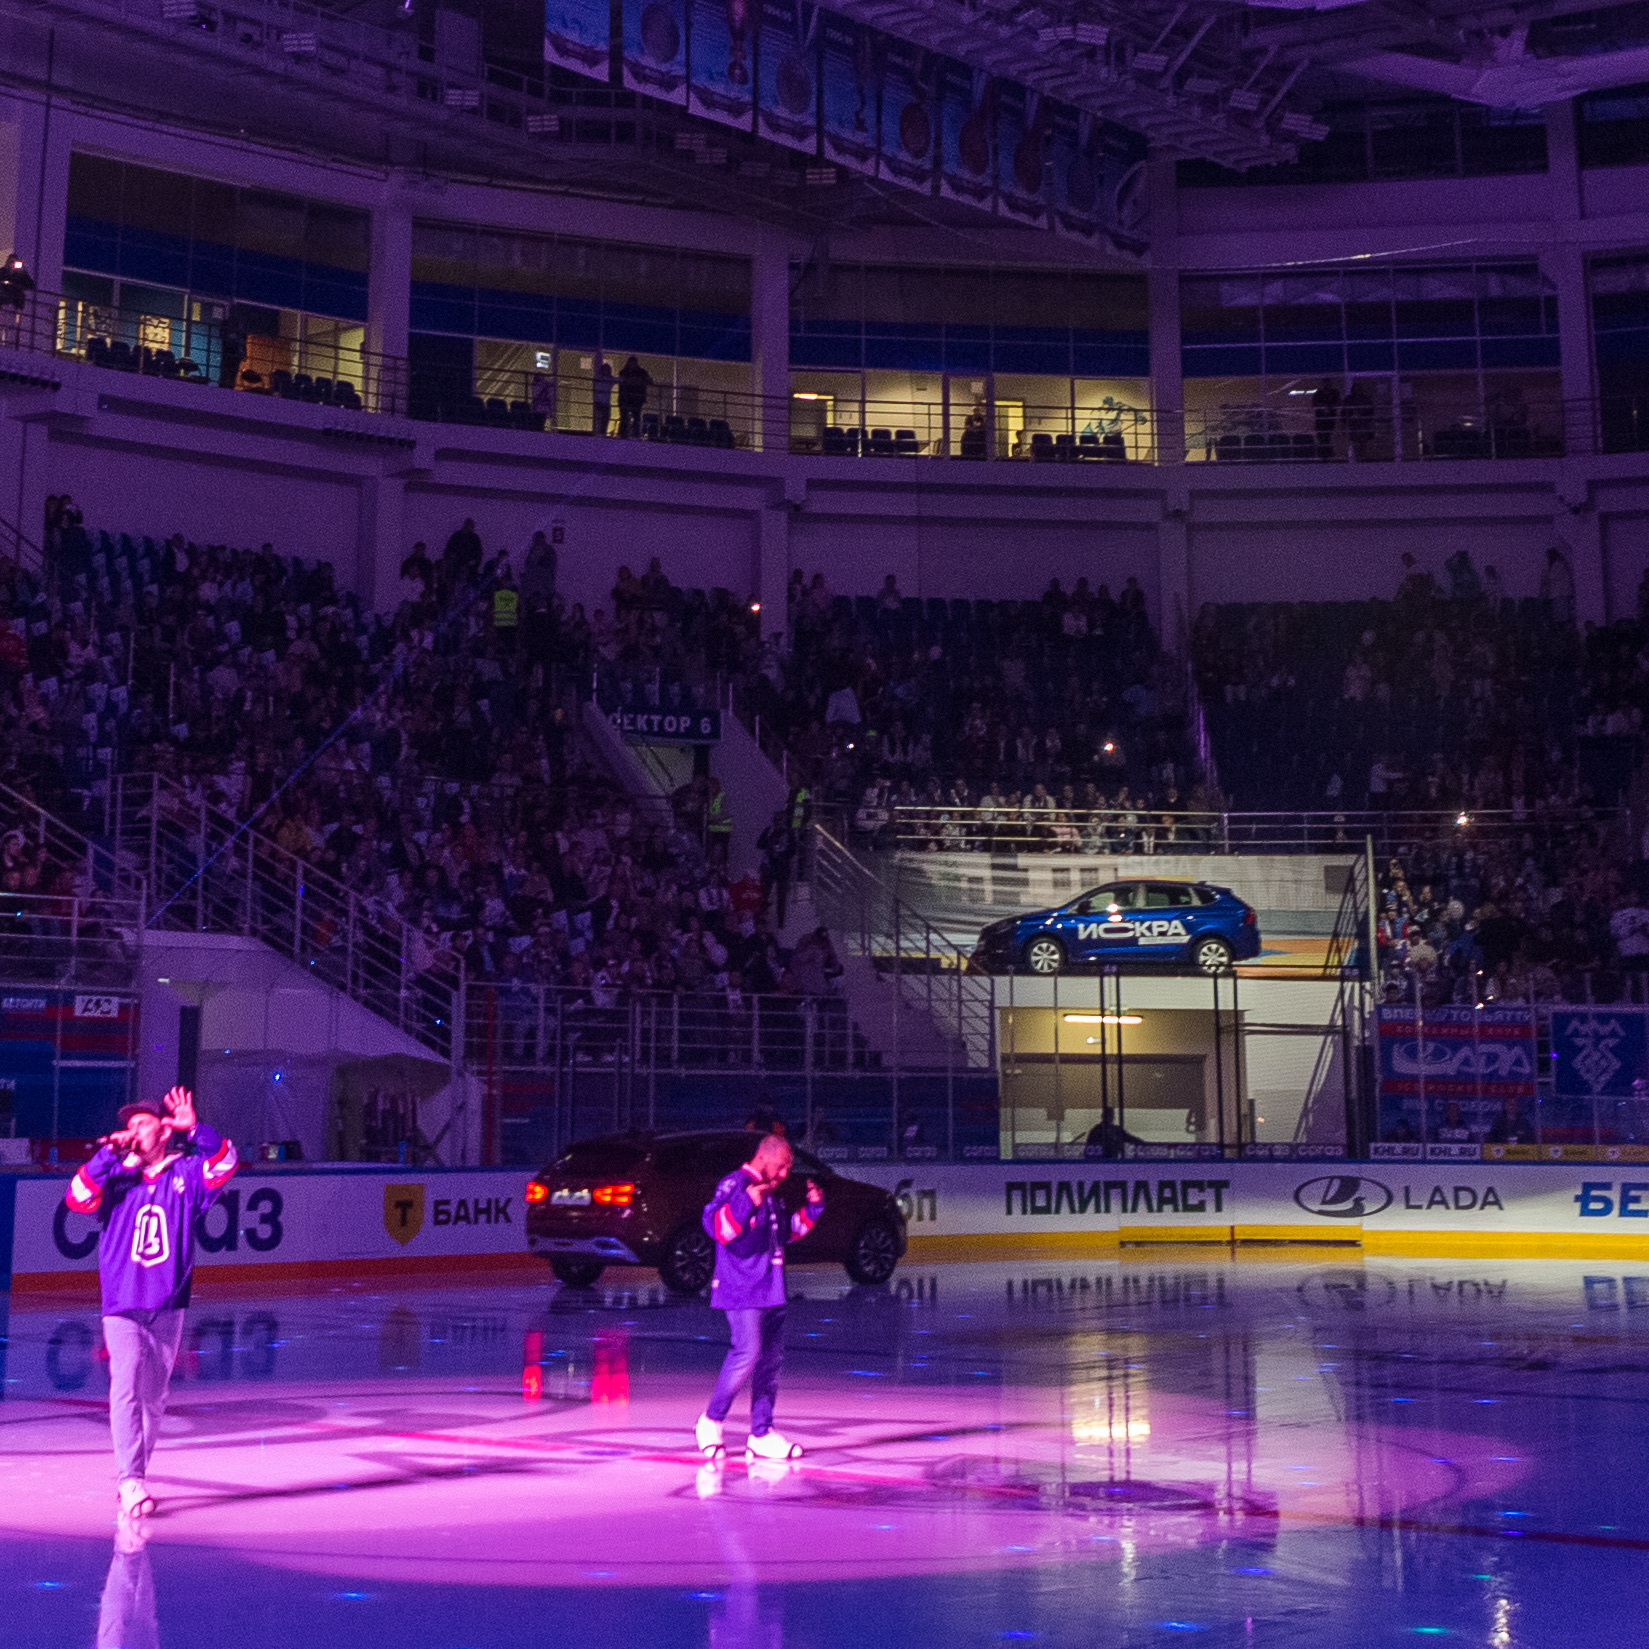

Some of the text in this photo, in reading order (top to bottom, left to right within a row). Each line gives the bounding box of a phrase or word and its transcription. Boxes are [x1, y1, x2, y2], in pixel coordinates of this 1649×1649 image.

[608, 713, 713, 735] СЕКТОР 6
[1372, 1143, 1420, 1157] KHL.RU
[1429, 1144, 1478, 1158] KHL.RU
[433, 1195, 514, 1226] БАНК
[895, 1178, 938, 1222] бп
[1004, 1179, 1231, 1216] ПОЛИПЛАСТ
[1403, 1184, 1506, 1212] LADA
[53, 1187, 285, 1260] саз
